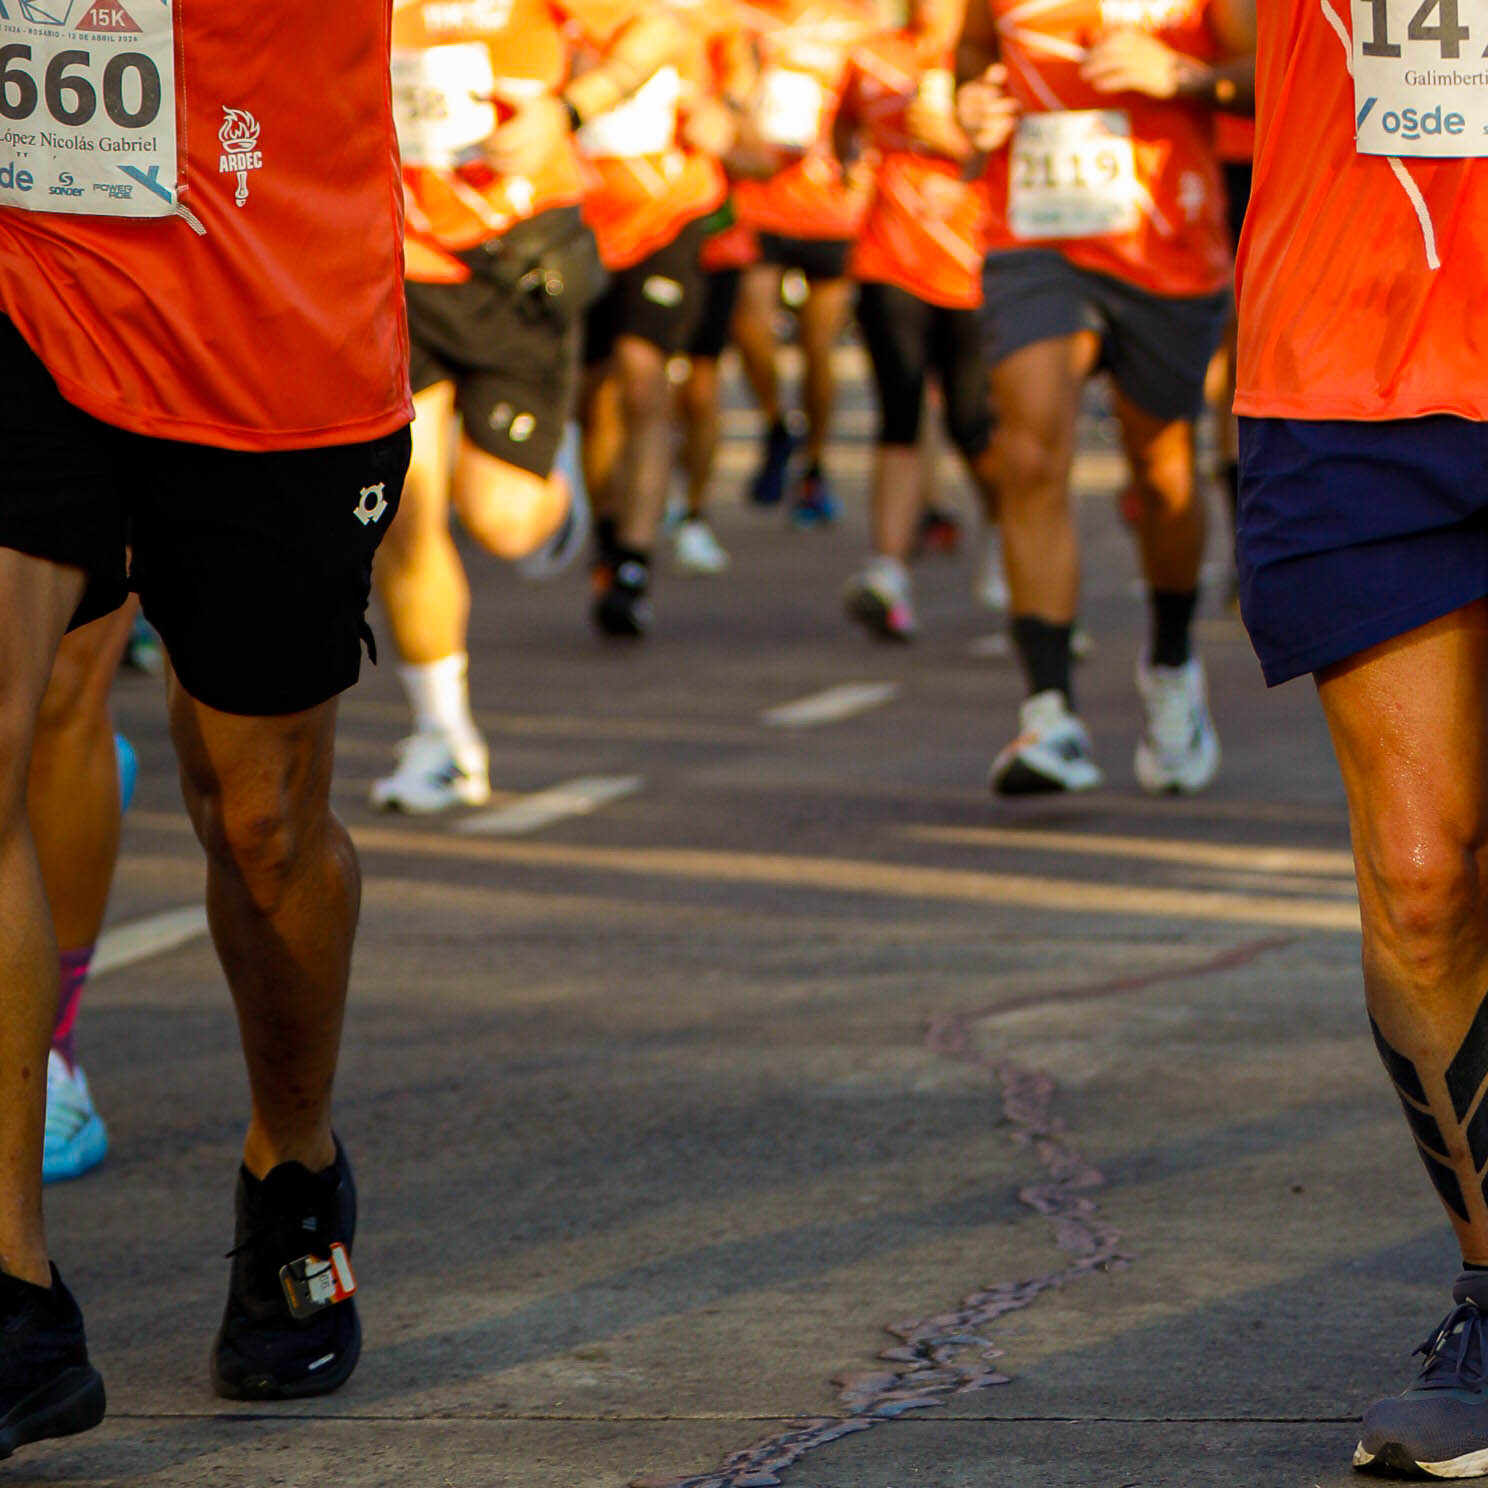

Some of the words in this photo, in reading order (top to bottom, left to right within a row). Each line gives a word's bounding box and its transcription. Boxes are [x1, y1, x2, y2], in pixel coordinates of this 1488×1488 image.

[89, 8, 126, 27] 15K
[0, 43, 161, 129] 660
[1404, 69, 1488, 87] Galimberti
[1382, 104, 1466, 139] osde
[40, 131, 95, 151] Nicolás
[98, 136, 157, 152] Gabriel
[219, 151, 263, 173] ARDEC
